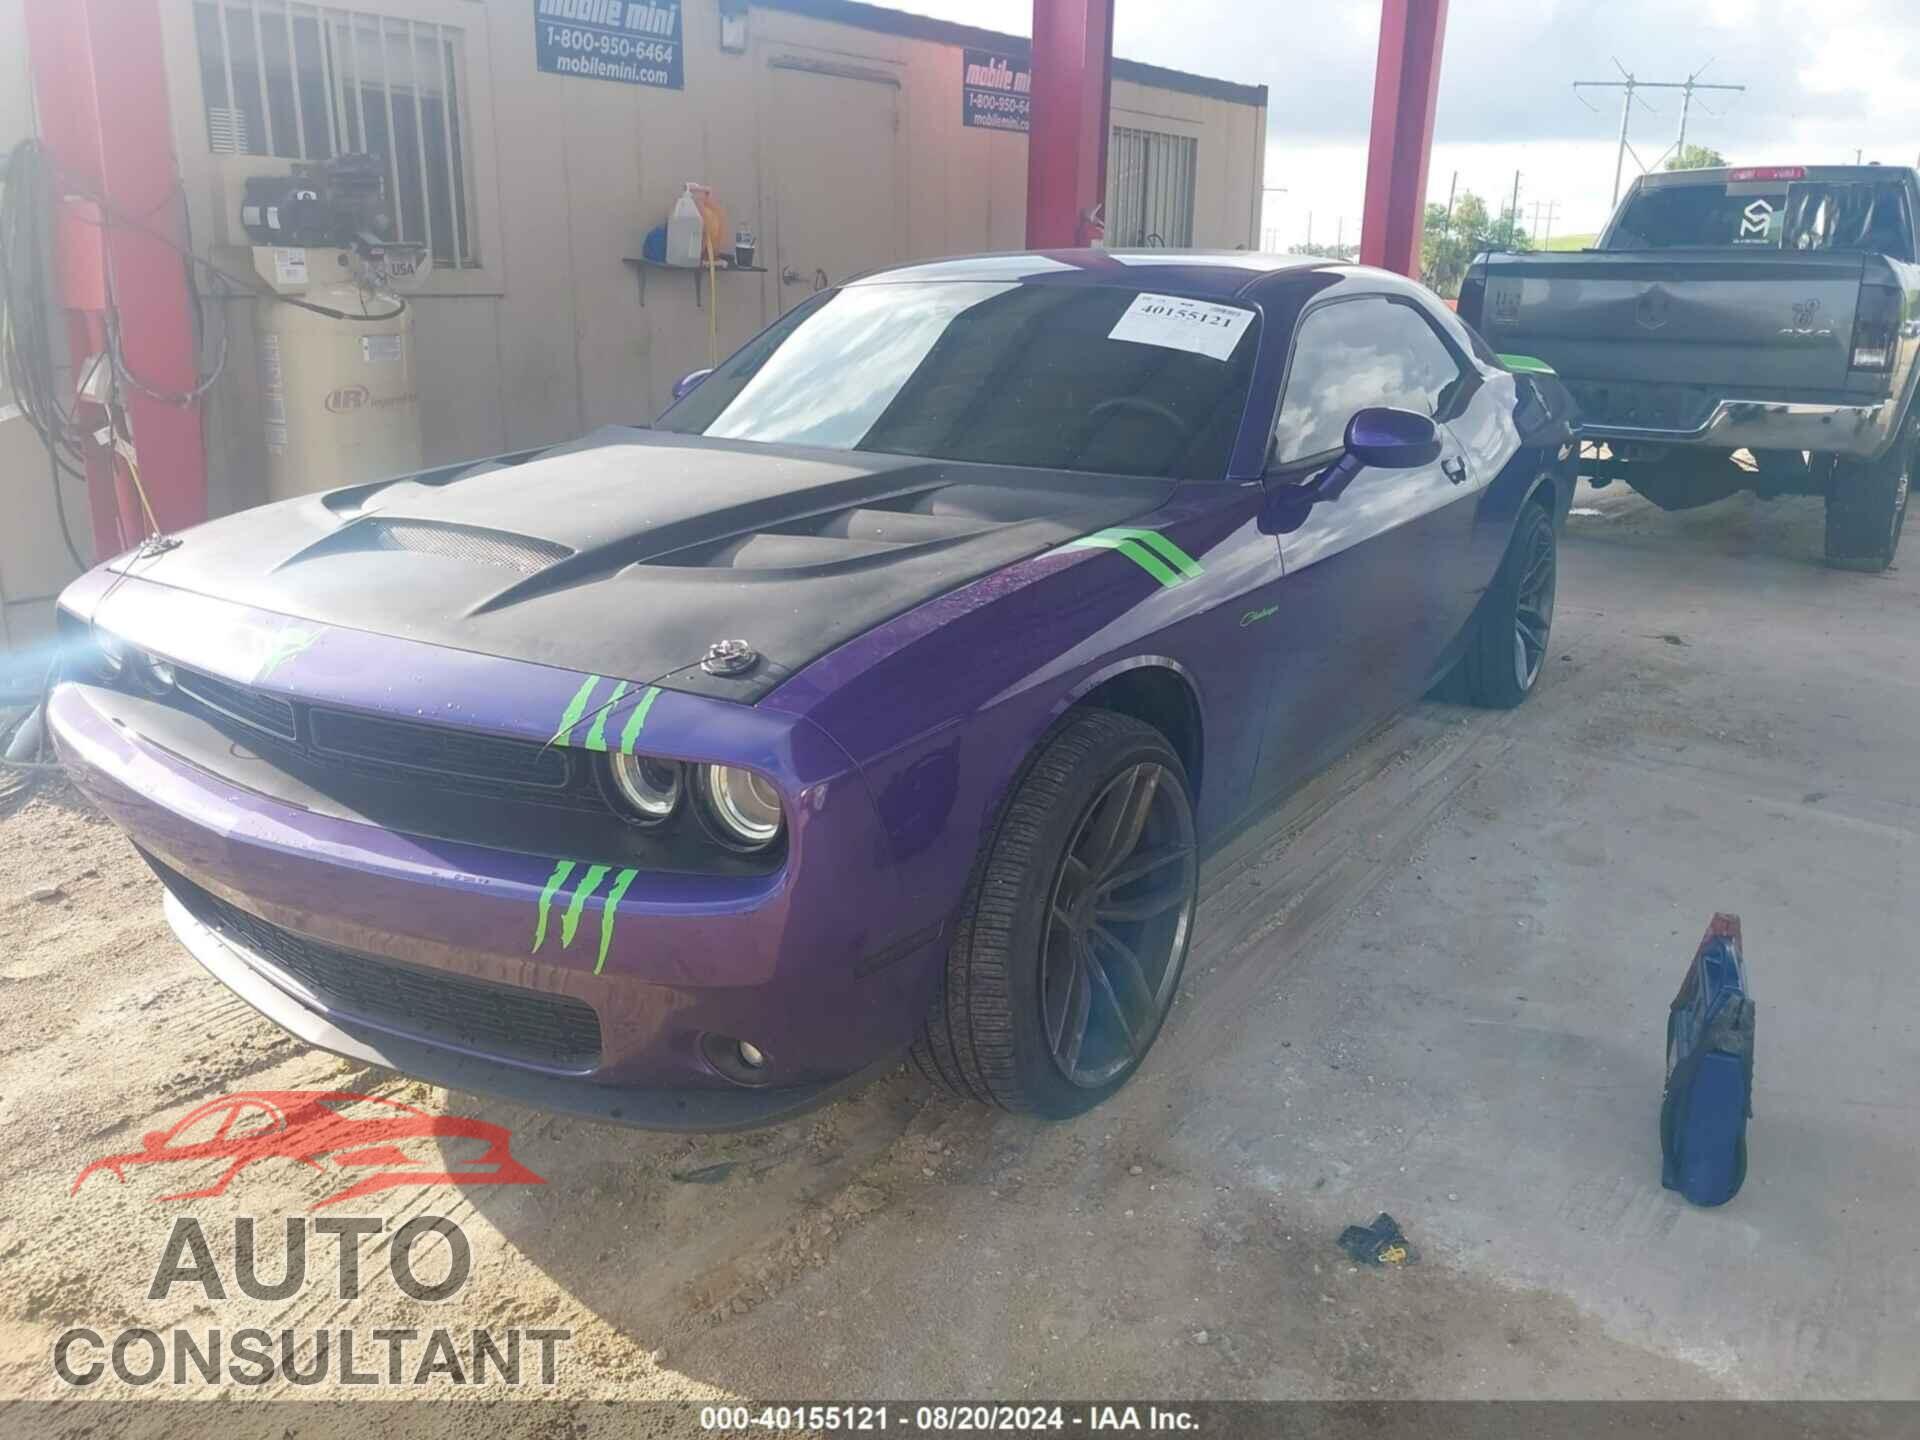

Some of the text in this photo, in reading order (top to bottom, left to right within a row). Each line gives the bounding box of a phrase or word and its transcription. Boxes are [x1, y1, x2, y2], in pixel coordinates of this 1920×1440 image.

[624, 1, 678, 36] mini
[546, 26, 673, 63] 1-800-950-6464
[556, 54, 669, 85] mobilemini.com
[966, 57, 1032, 93] mobile mi
[391, 262, 415, 274] USA
[1141, 304, 1233, 329] 40155121
